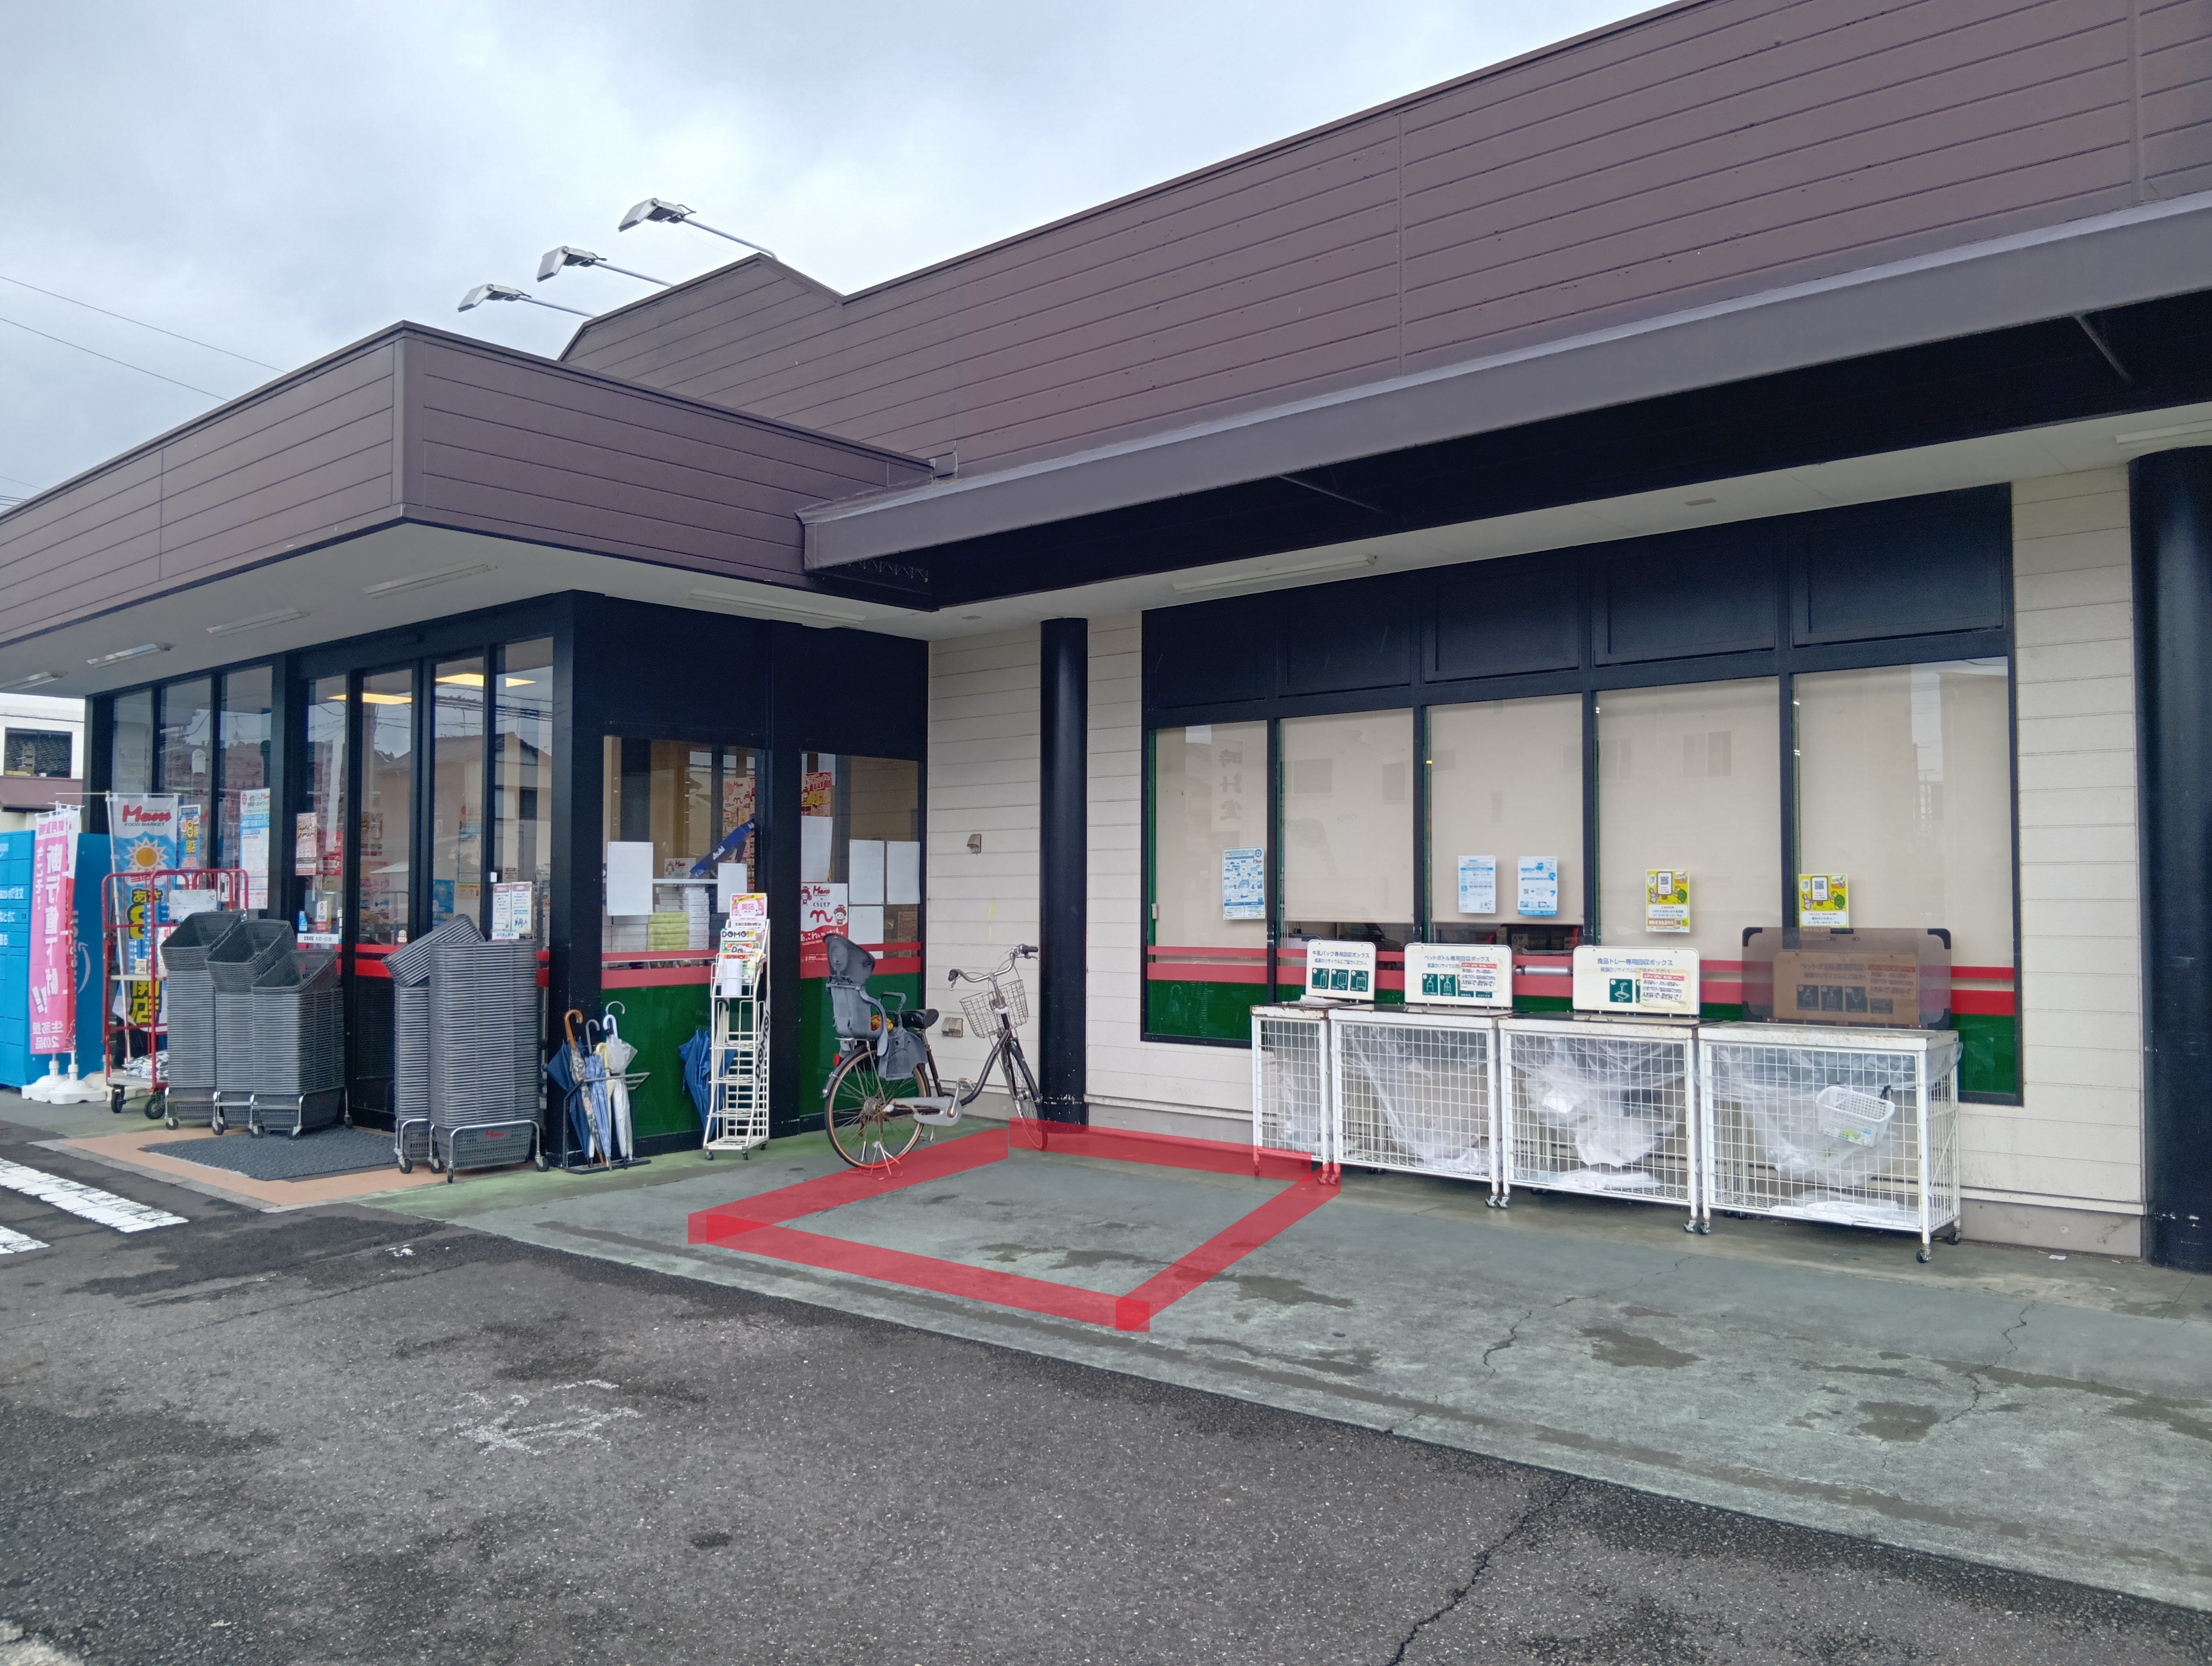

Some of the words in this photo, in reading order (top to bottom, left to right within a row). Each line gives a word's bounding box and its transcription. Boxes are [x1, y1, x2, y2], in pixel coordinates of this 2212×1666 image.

[122, 805, 171, 823] Mom
[813, 886, 831, 895] Mom
[1597, 958, 1673, 966] 食品トレー専用回収ボックス
